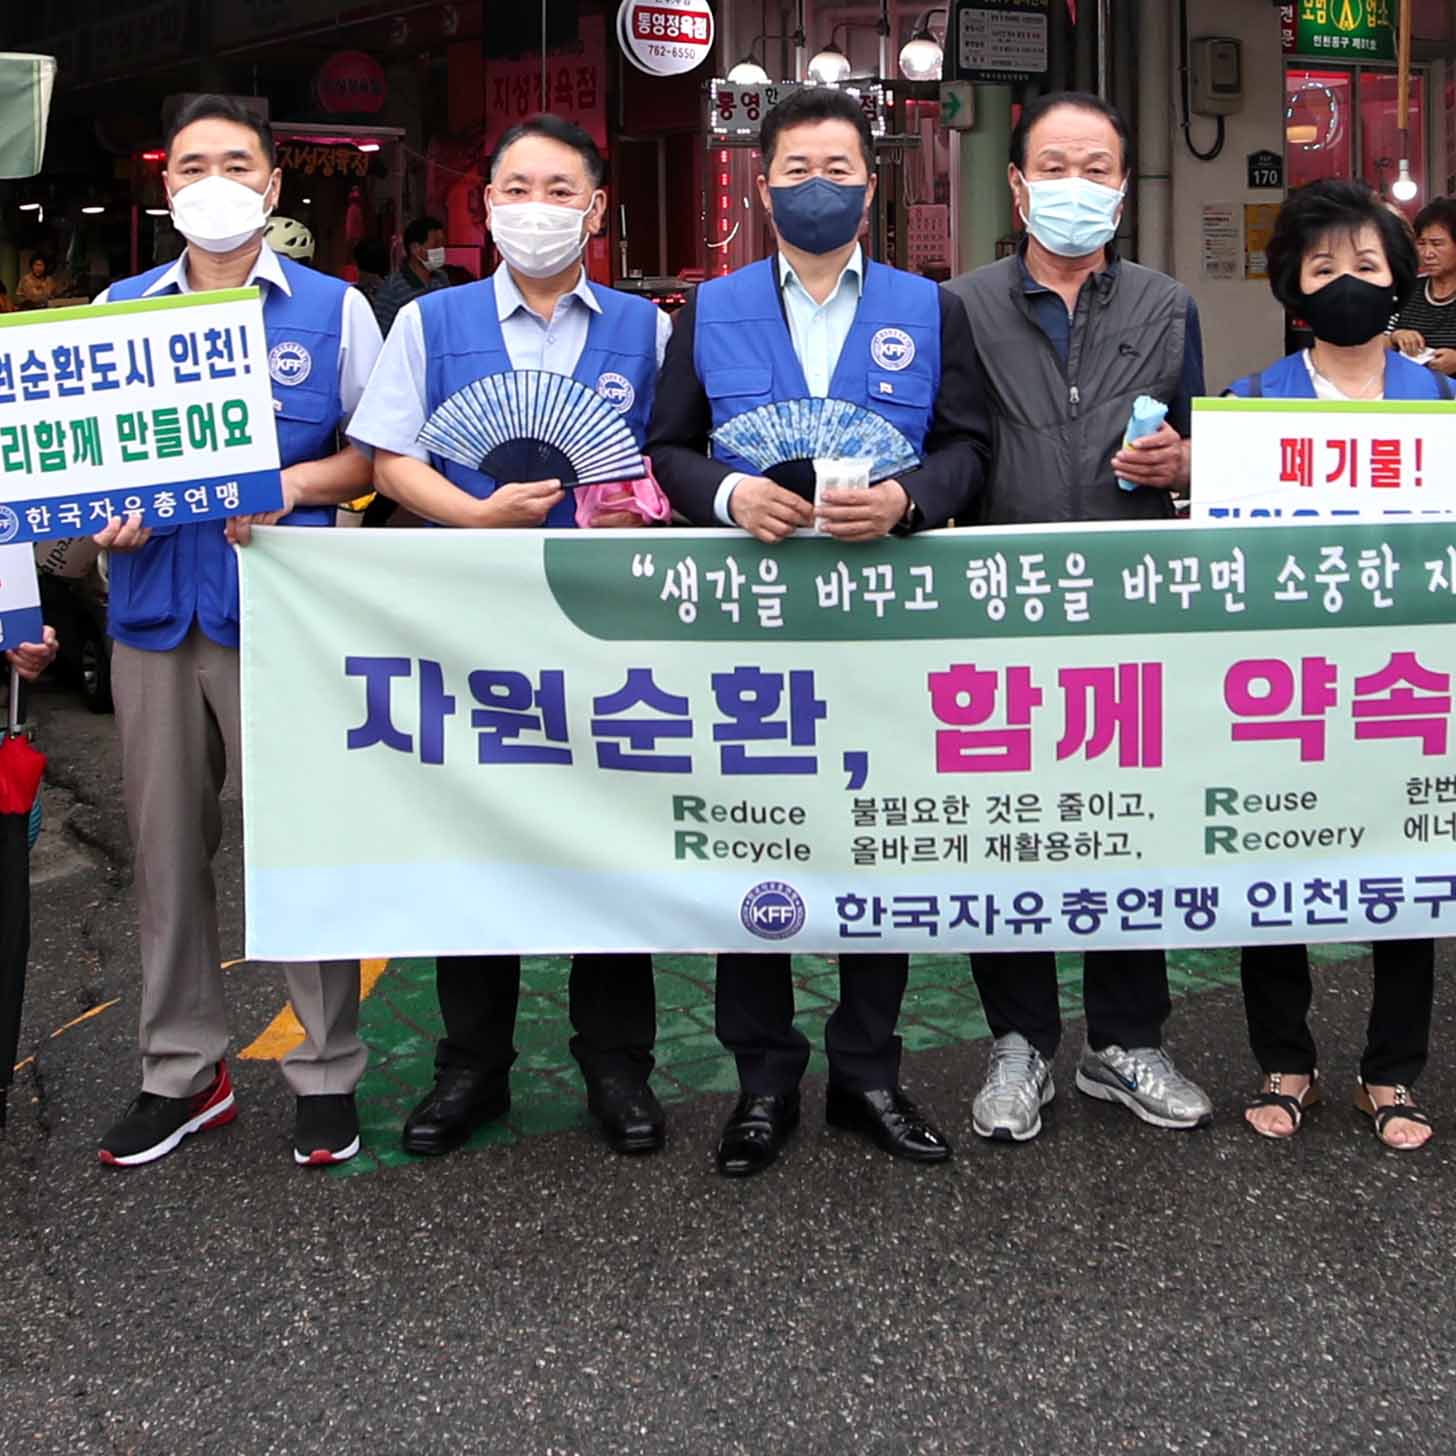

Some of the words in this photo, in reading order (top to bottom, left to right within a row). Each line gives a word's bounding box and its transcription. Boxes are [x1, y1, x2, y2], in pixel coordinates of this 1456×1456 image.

[638, 11, 708, 40] 통영정육점
[647, 44, 696, 60] 762-6550
[1252, 169, 1278, 185] 170
[168, 324, 252, 384] 인천!
[115, 397, 253, 463] 만들어요
[1279, 437, 1425, 489] 폐기물!
[24, 481, 240, 534] 한국자유총연맹
[631, 553, 789, 628] “생각을
[814, 559, 940, 614] 바꾸고
[965, 554, 1095, 623] 행동을
[1121, 553, 1247, 612] 바꾸면
[1274, 543, 1399, 610] 소중한
[344, 655, 870, 790] 자원순환,
[927, 662, 1163, 775] 함께
[671, 794, 807, 826] Reduce
[850, 794, 971, 828] 불필요한
[983, 791, 1044, 825] 것은
[1056, 790, 1156, 824] 줄이고,
[1203, 785, 1318, 818] Reuse
[674, 830, 812, 863] Recycle
[850, 831, 971, 865] 올바르게
[983, 830, 1144, 863] 재활용하고,
[1203, 821, 1366, 856] Recovery
[750, 903, 796, 925] KFF
[834, 884, 1220, 939] 한국자유총연맹
